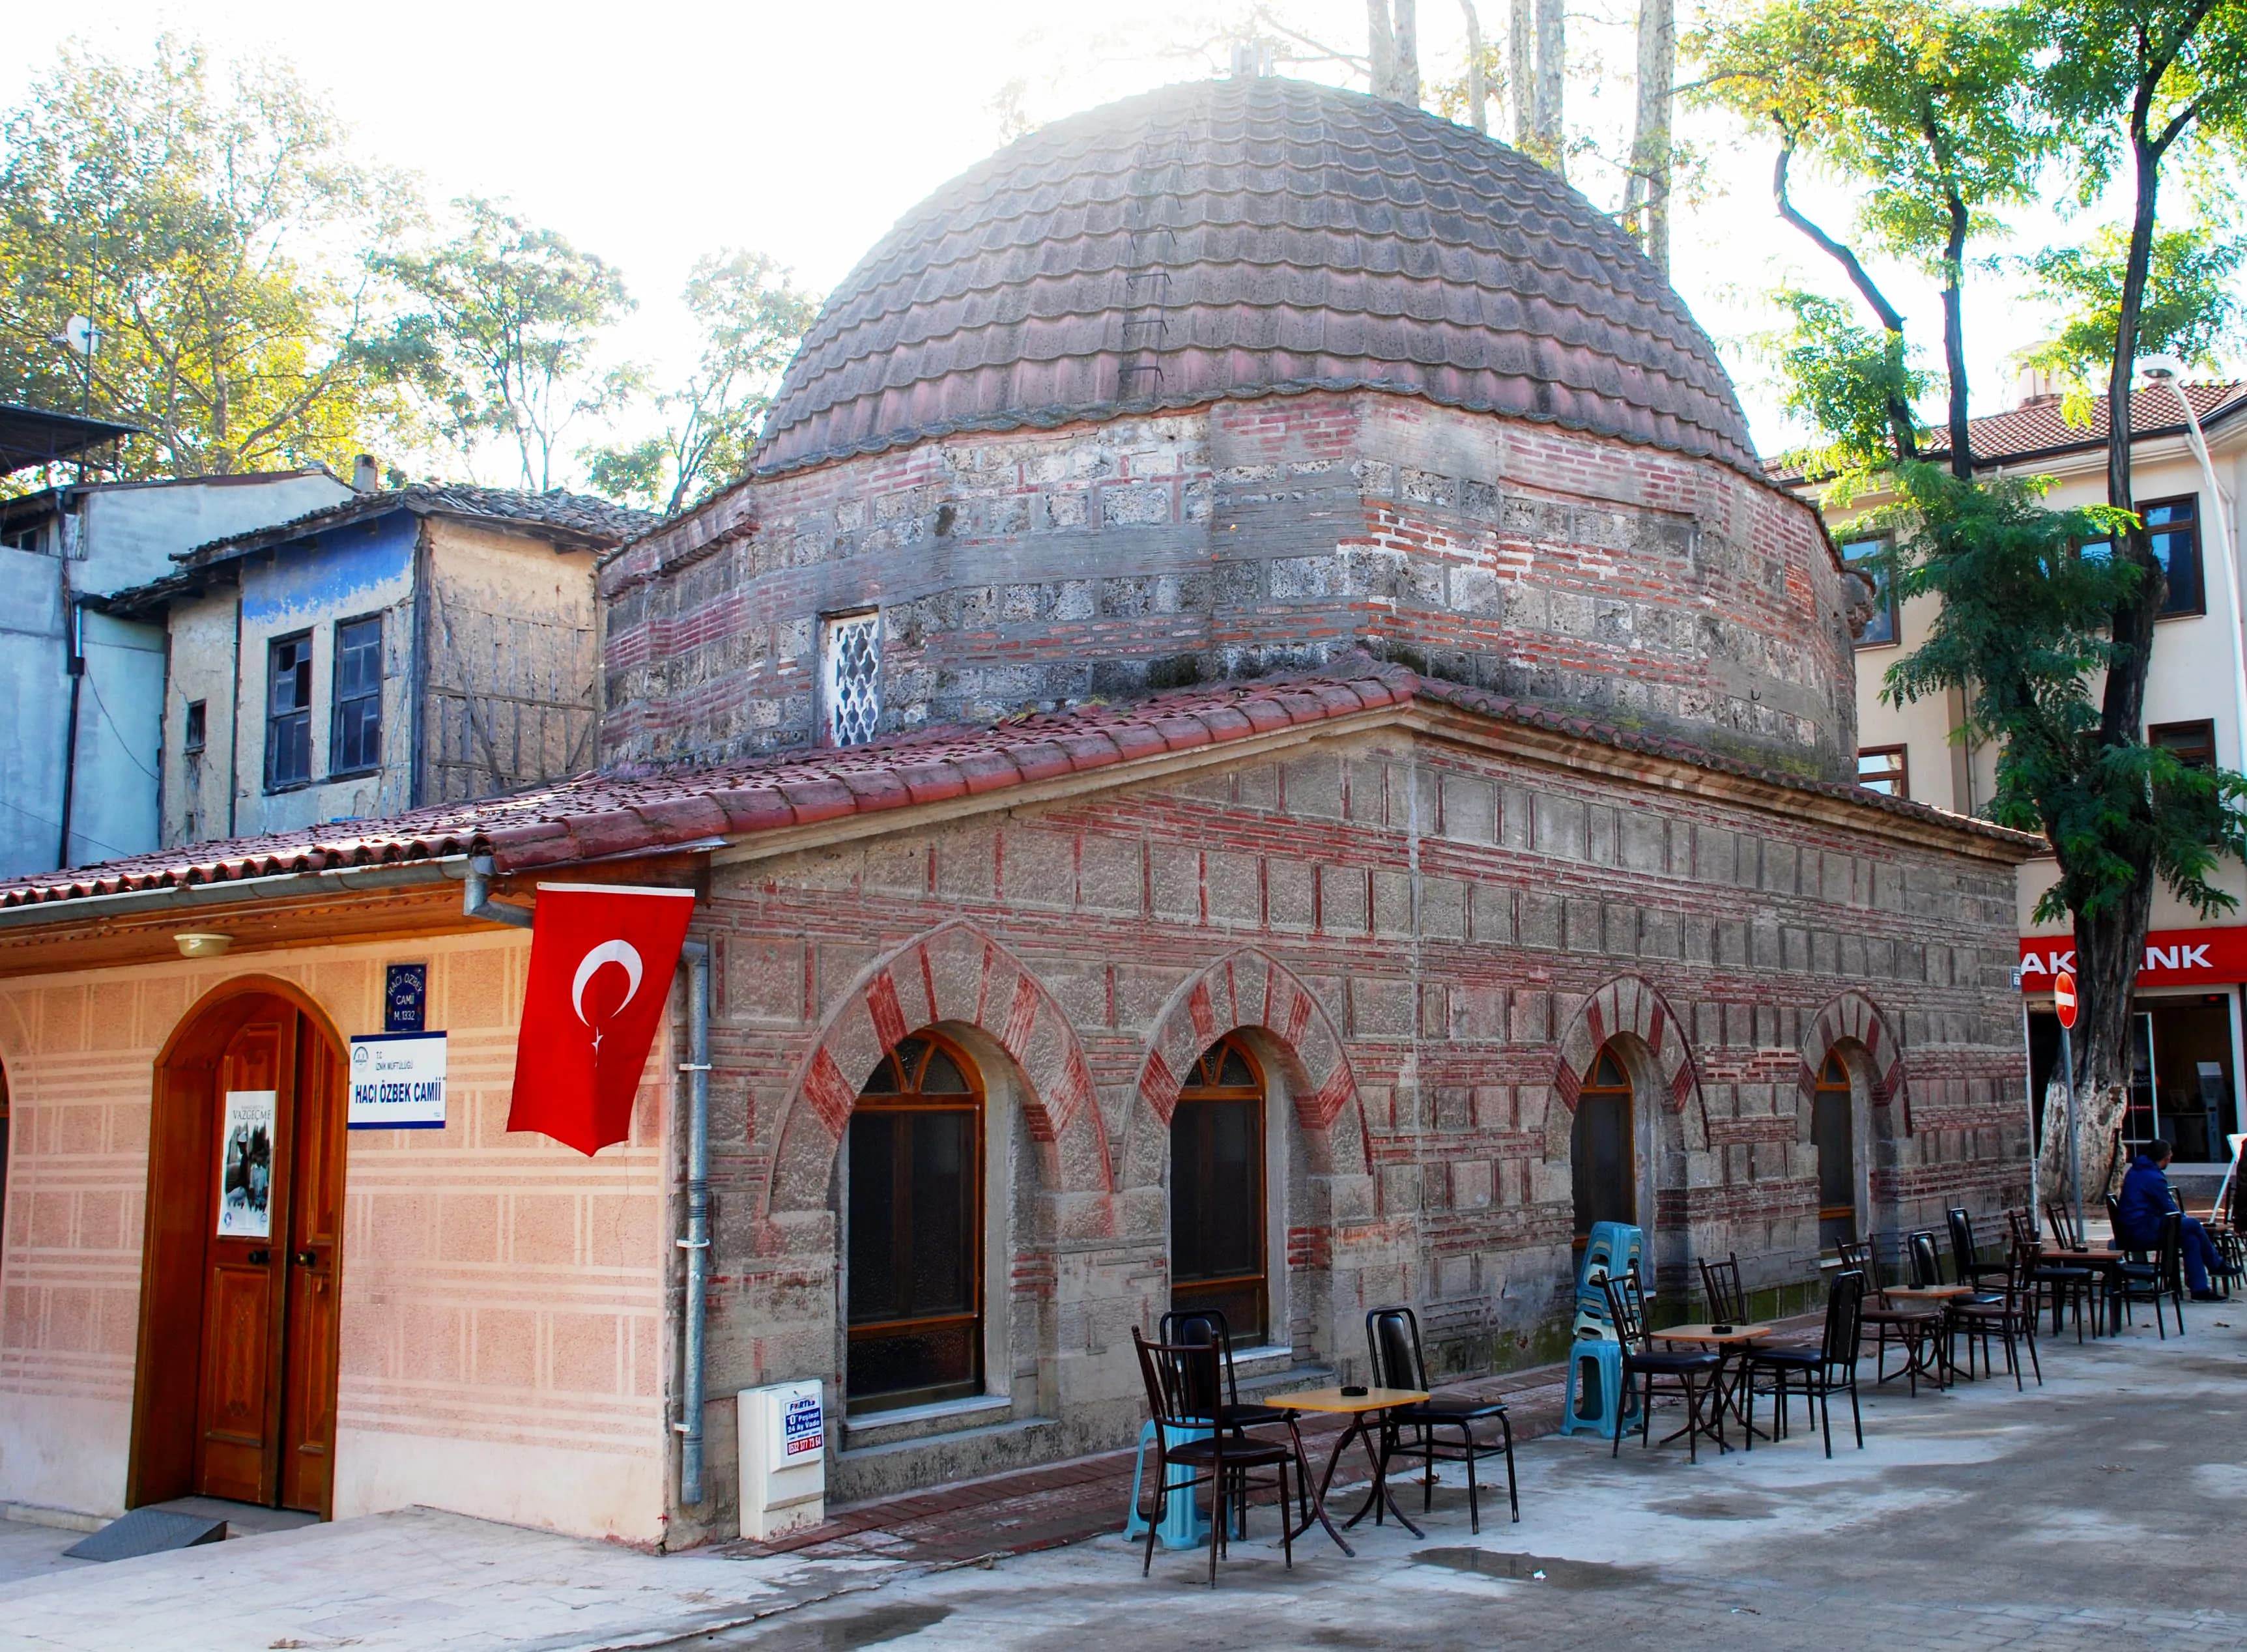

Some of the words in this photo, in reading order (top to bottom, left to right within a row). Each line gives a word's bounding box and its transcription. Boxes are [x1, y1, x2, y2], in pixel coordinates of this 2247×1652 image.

[2020, 944, 2214, 975] AKNK
[355, 1084, 377, 1104] HACI
[380, 1079, 411, 1102] ÖZBEK
[414, 1076, 441, 1102] CAMİİ
[233, 1110, 271, 1121] VAZGEÇME
